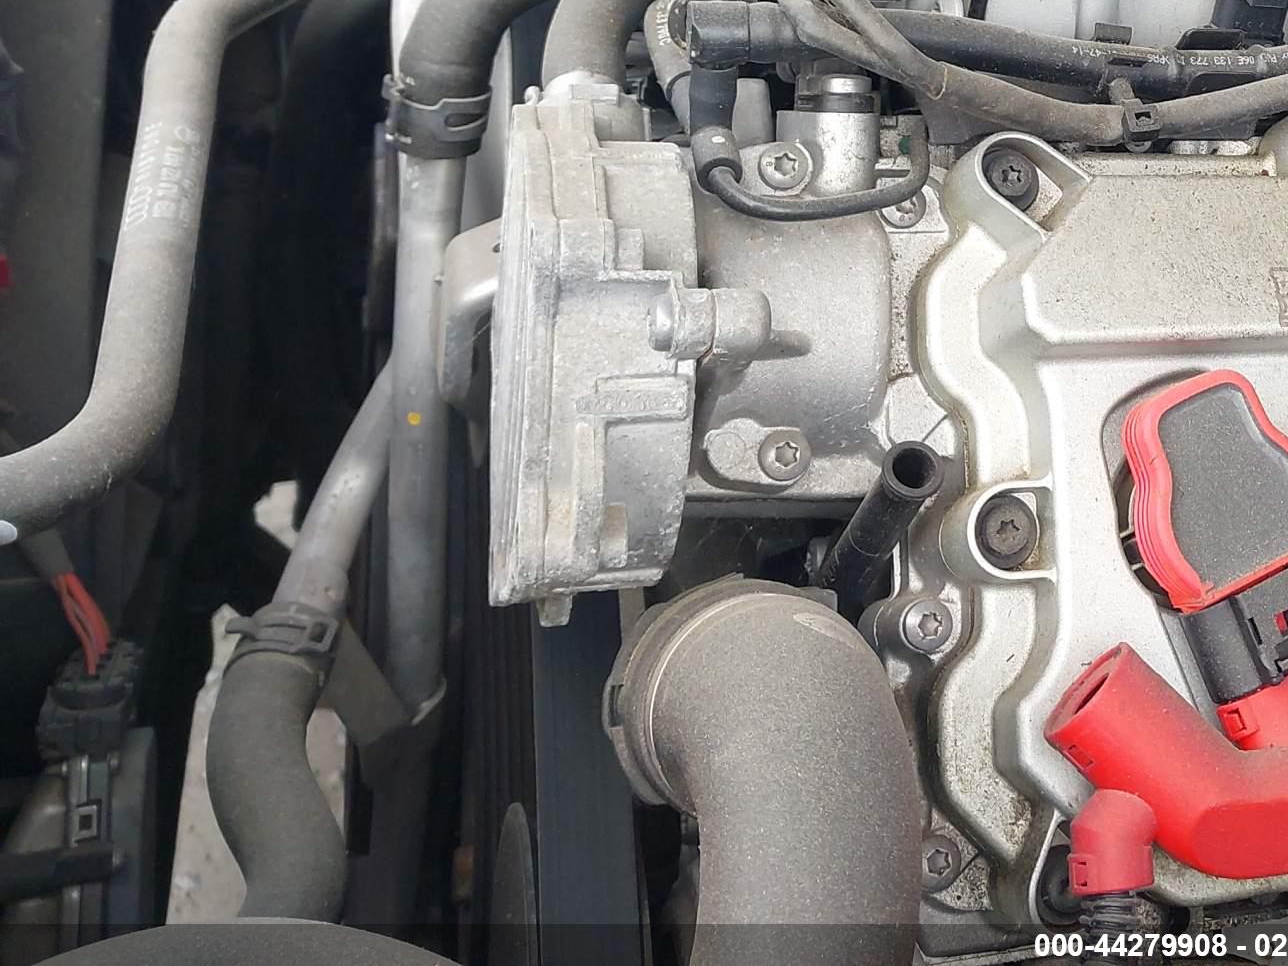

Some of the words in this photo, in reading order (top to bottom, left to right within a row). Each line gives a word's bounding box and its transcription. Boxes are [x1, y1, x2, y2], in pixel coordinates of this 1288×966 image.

[1189, 55, 1209, 66] 773
[1213, 55, 1232, 66] 133
[1236, 55, 1256, 66] 06E
